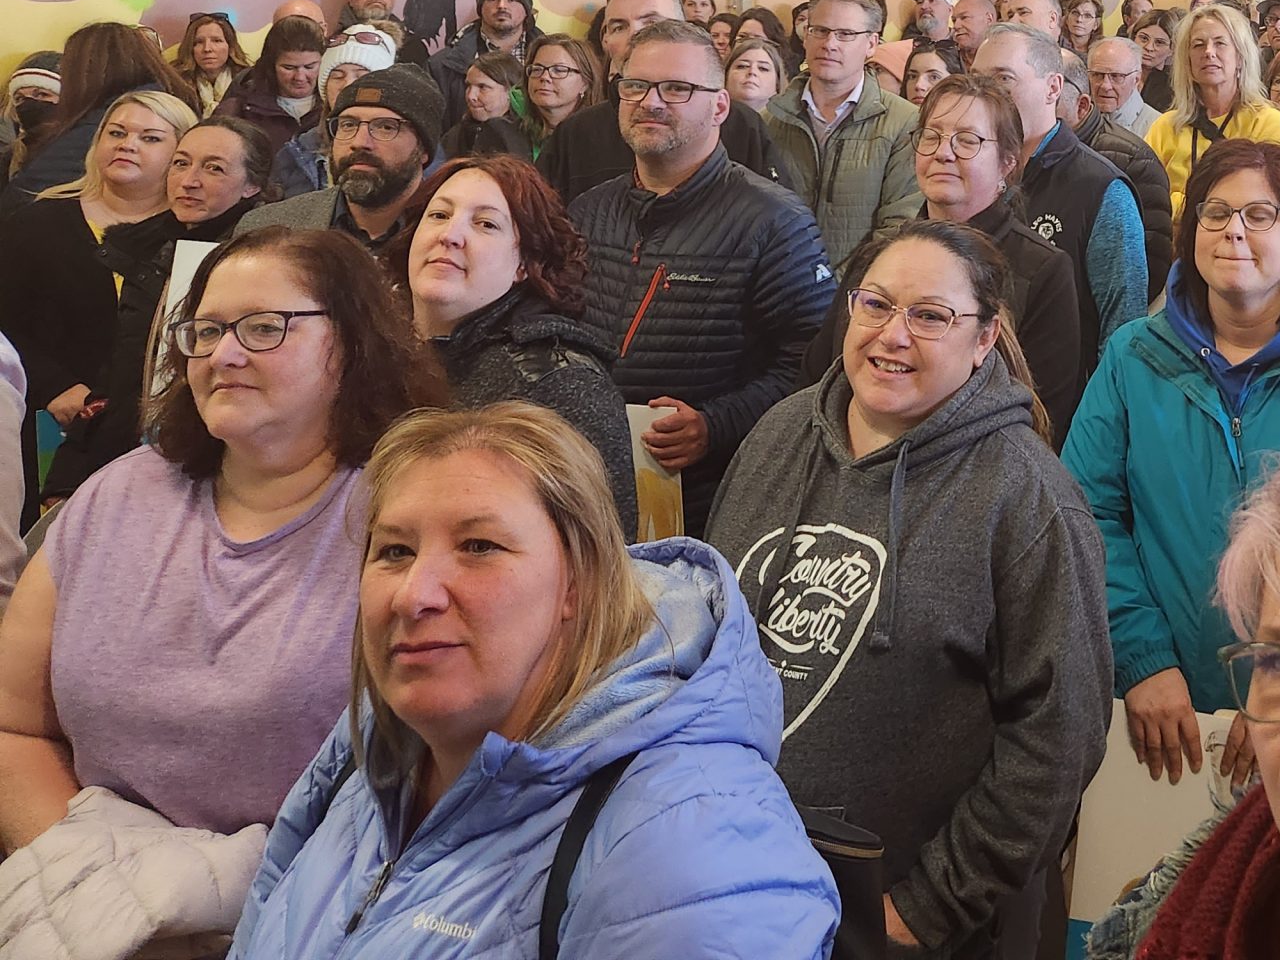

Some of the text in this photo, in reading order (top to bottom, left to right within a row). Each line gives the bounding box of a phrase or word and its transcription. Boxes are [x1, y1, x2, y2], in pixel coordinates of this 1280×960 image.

[1044, 213, 1063, 232] HAYES
[759, 533, 872, 607] Country
[783, 669, 809, 681] COUNTY
[422, 913, 478, 940] Columbi
